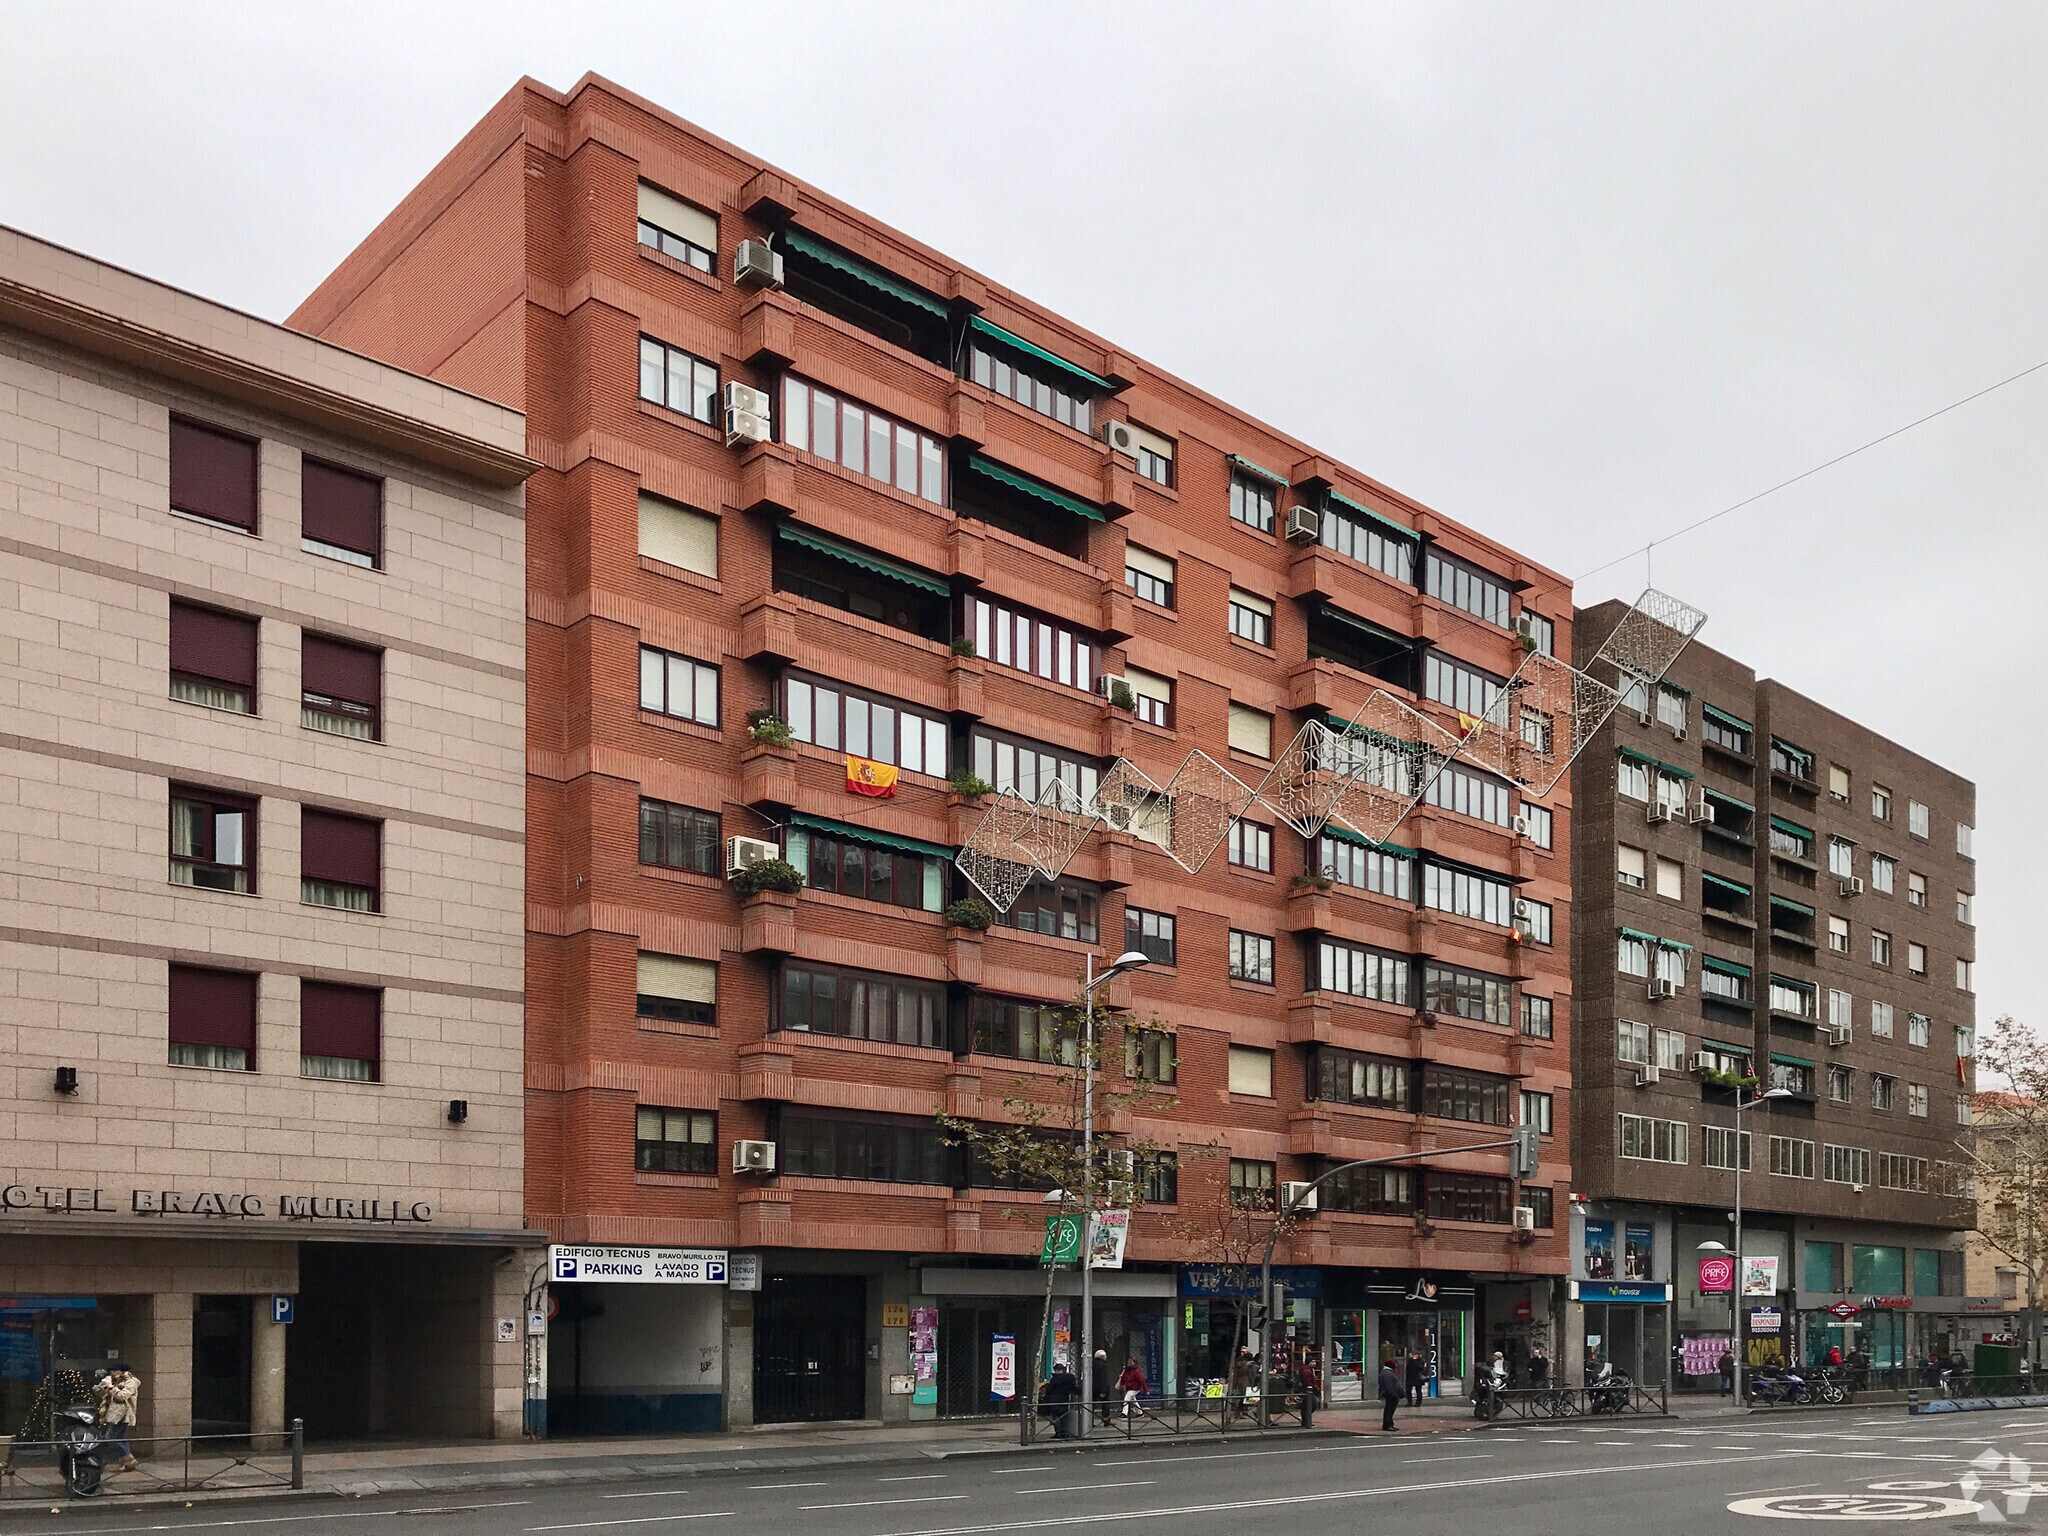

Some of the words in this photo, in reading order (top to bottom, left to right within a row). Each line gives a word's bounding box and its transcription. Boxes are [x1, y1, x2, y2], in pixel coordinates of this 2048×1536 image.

[132, 1189, 265, 1216] BRAVO
[279, 1195, 432, 1222] MURILLO
[555, 1248, 603, 1258] EDIFICIO
[606, 1249, 651, 1259] TECNUS
[558, 1259, 576, 1277] P
[584, 1263, 643, 1275] PARKING
[654, 1262, 699, 1271] LAVADO
[708, 1263, 724, 1280] P
[731, 1266, 755, 1274] TECNUS
[666, 1271, 699, 1279] MANO
[1619, 1288, 1641, 1296] movistar
[276, 1297, 290, 1320] P
[996, 1356, 1010, 1371] 20
